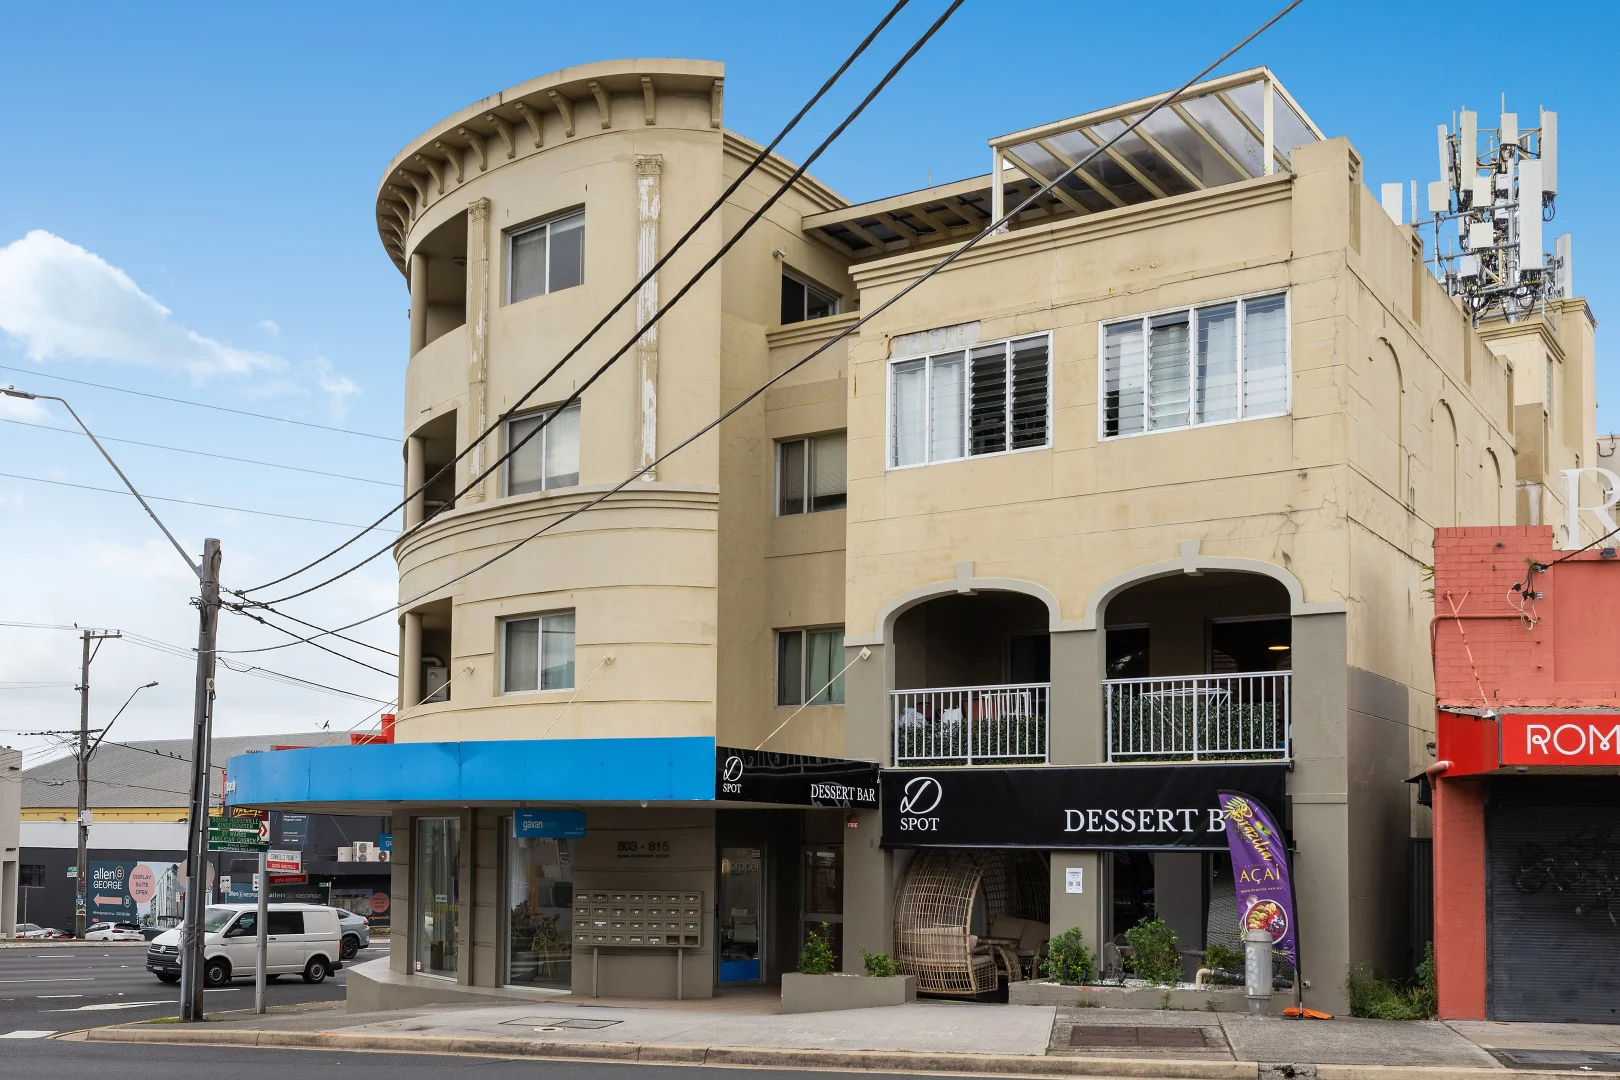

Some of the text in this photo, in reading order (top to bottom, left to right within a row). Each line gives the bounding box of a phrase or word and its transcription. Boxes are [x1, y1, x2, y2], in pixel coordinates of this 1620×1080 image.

[1559, 468, 1620, 550] R
[1527, 724, 1620, 755] ROM
[723, 756, 743, 782] D
[722, 783, 742, 793] SPOT
[810, 783, 876, 802] DESSERT BAR
[900, 776, 943, 815] D
[900, 817, 940, 831] SPOT
[1064, 809, 1226, 833] DESSERT B
[617, 841, 637, 851] 803
[648, 841, 669, 851] 815
[93, 867, 115, 880] allen
[1239, 863, 1281, 885] AÇAÍ
[93, 880, 123, 890] GEORGE
